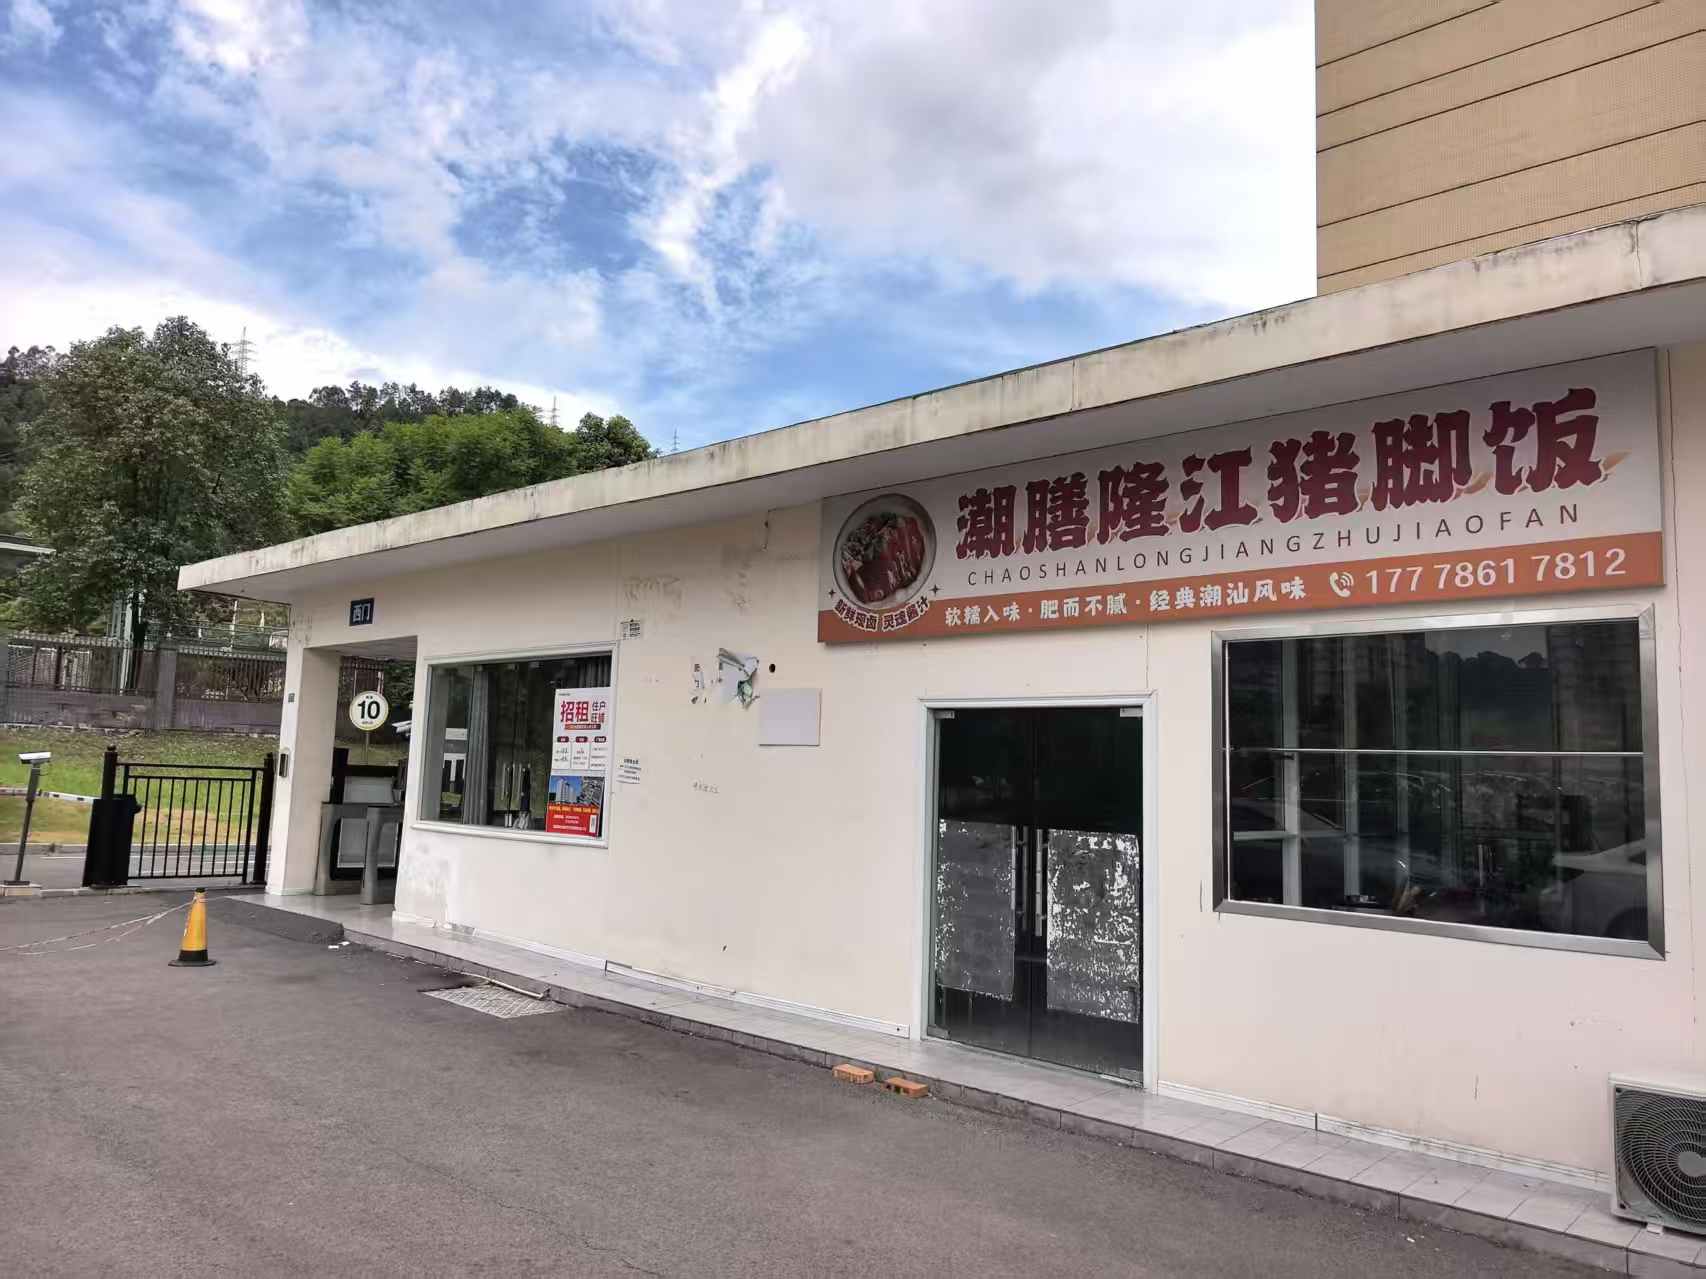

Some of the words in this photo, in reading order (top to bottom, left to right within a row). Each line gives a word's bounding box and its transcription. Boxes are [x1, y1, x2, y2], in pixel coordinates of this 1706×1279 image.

[955, 387, 1603, 560] 潮膳隆江猪脚饭
[967, 503, 1580, 587] CHAOSHANLONGJIANGZHUJIAOFAN
[1365, 567, 1423, 595] 177
[1433, 557, 1517, 592] 7861
[1531, 547, 1627, 582] 7812
[357, 700, 380, 719] 10
[560, 701, 589, 722] 招租
